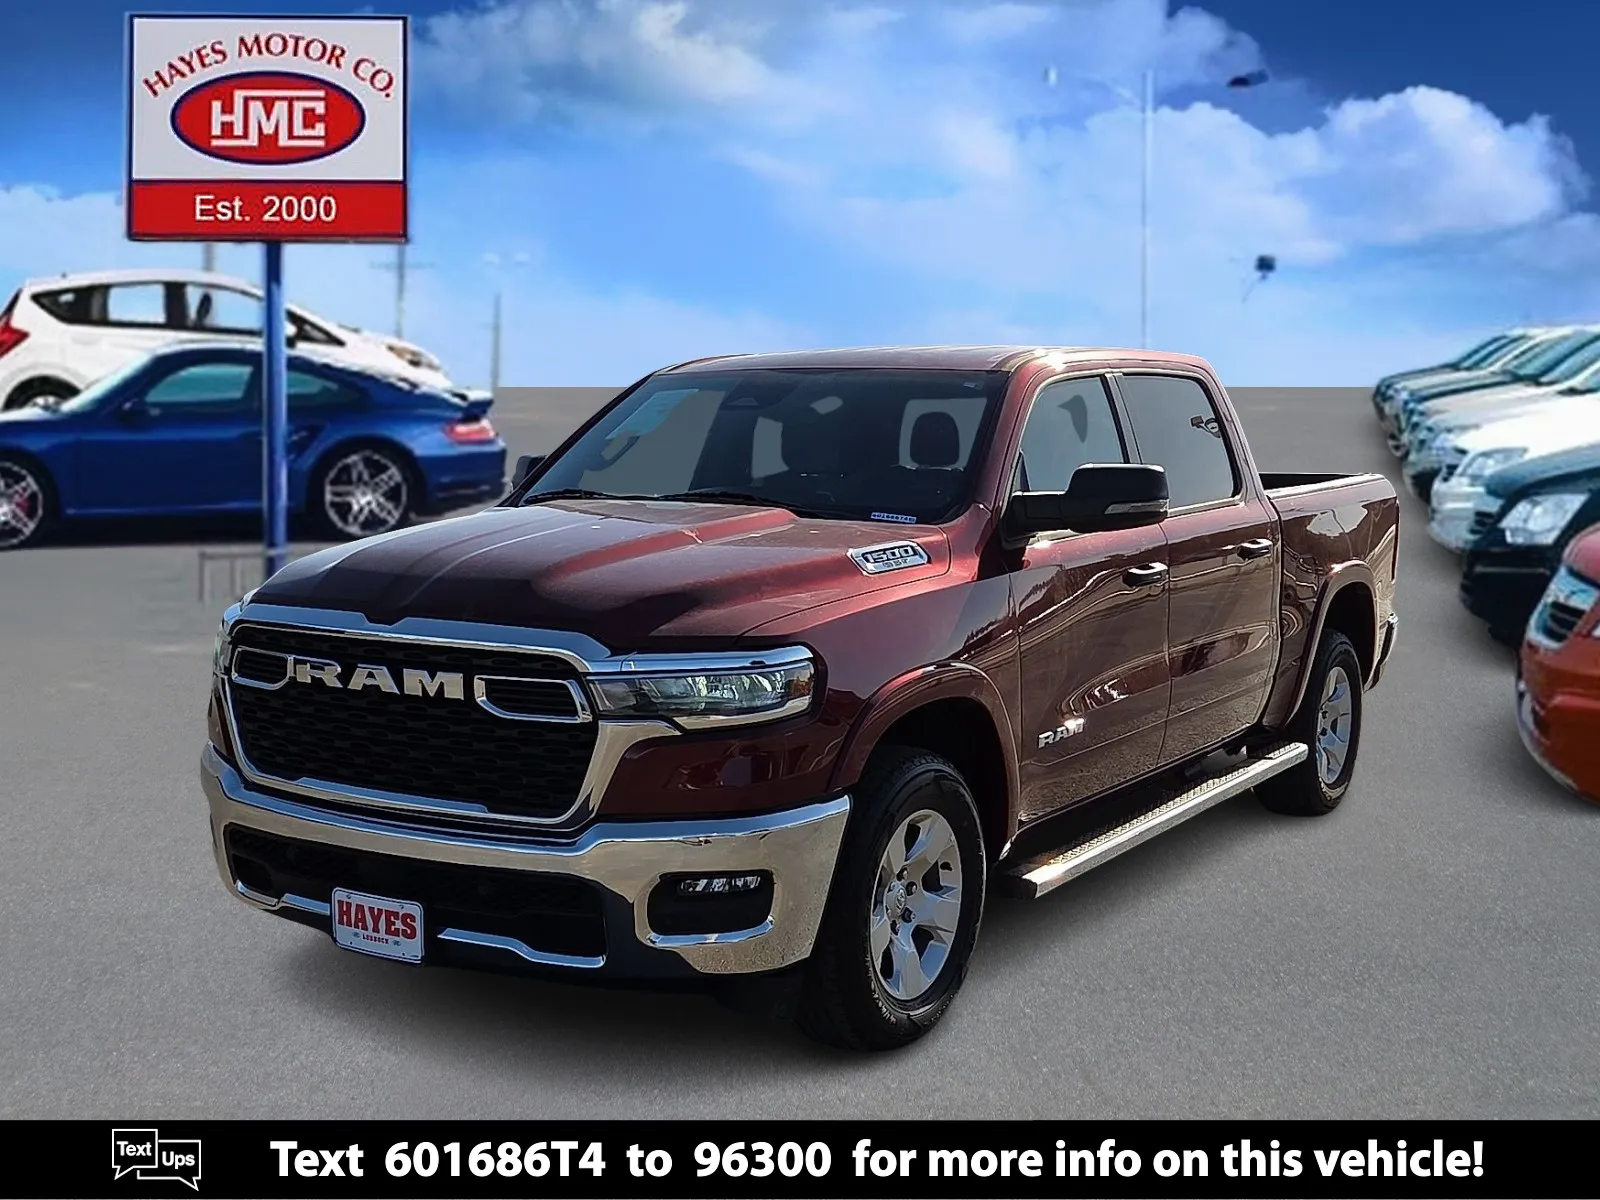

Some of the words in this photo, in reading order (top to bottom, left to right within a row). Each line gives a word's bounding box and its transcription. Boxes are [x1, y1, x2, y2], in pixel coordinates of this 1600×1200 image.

[142, 40, 228, 98] HAYES
[237, 33, 347, 69] MOTOR
[352, 57, 395, 98] CO.
[210, 89, 326, 147] HMC
[194, 195, 250, 221] Est.
[262, 195, 337, 222] 2000
[863, 545, 915, 563] 1500
[290, 655, 464, 700] RAM
[1038, 717, 1085, 749] RAM
[337, 899, 417, 940] HAYES
